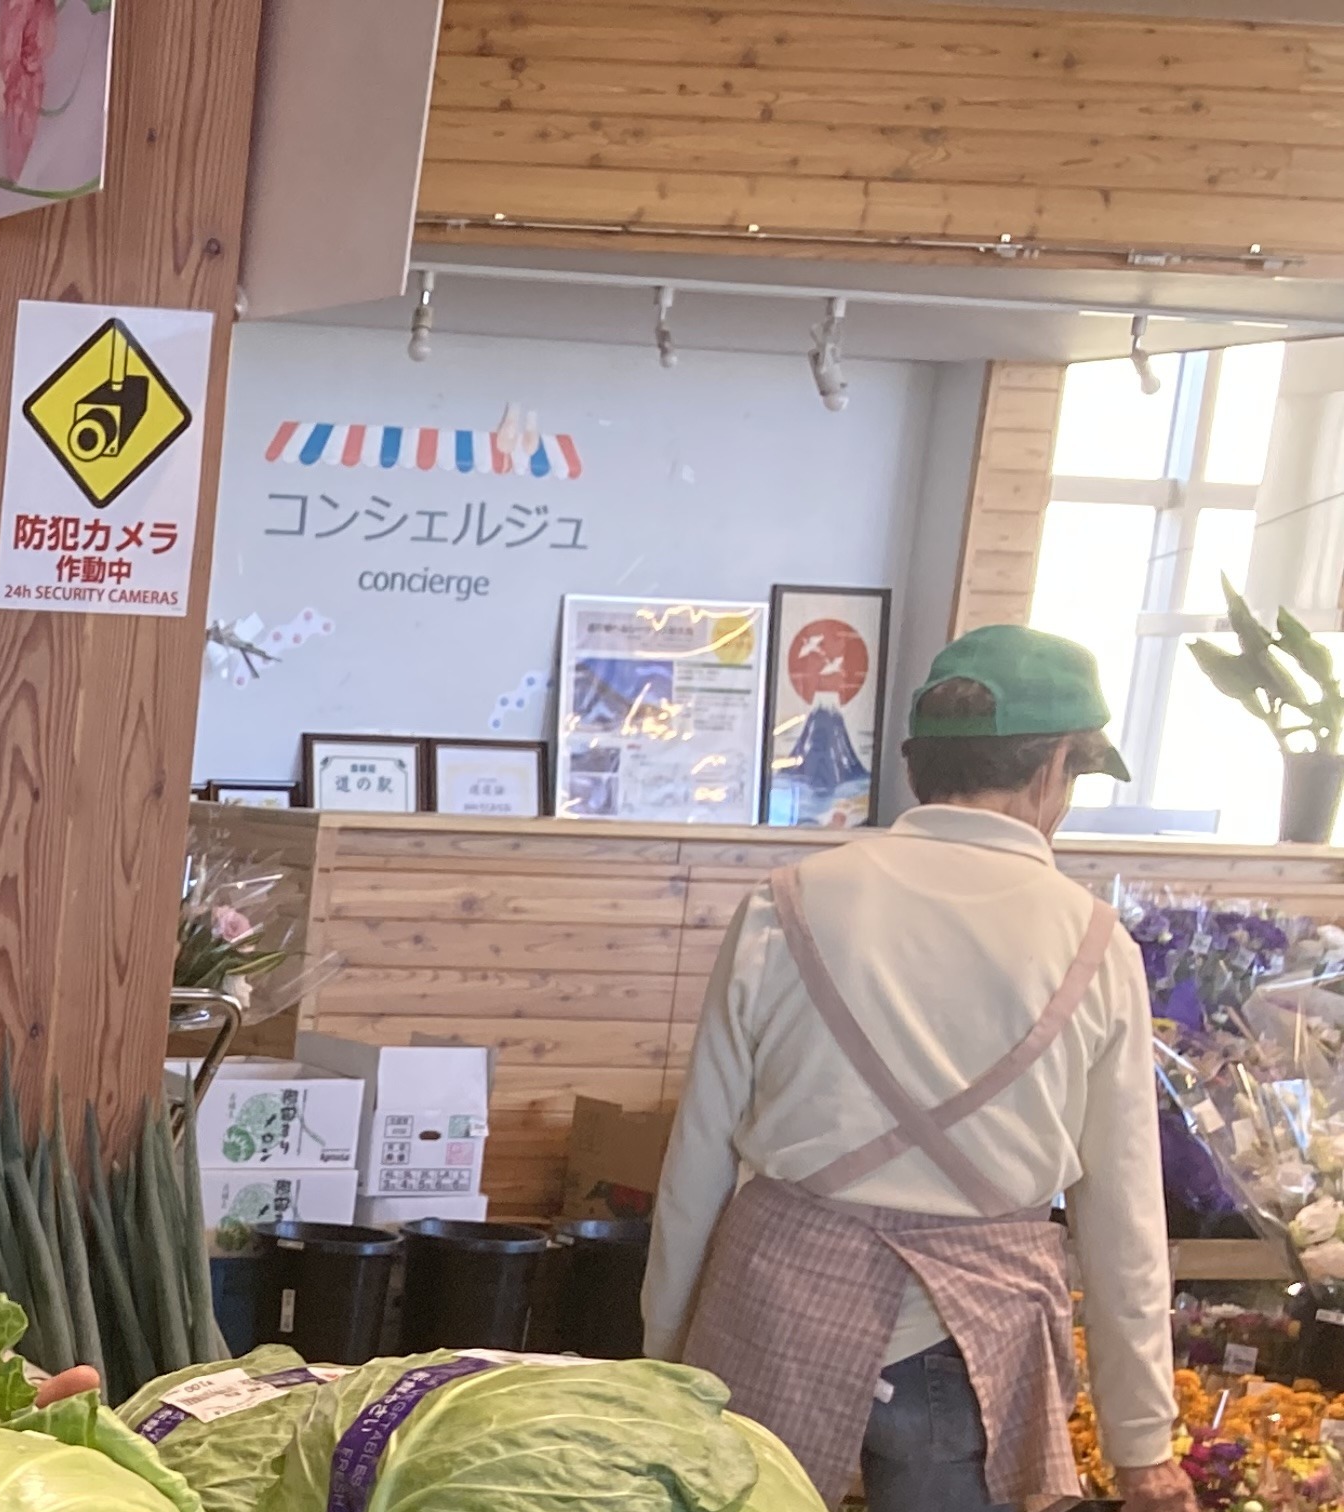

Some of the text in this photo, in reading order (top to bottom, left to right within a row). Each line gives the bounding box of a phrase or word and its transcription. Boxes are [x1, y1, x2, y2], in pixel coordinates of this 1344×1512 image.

[13, 513, 179, 555] 防犯カメラ
[264, 492, 588, 551] コンシェルジュ
[55, 554, 133, 585] 作動中
[358, 567, 491, 602] concierge
[4, 584, 179, 605] 24h SECURITY CAMERAS
[334, 774, 395, 794] 道の駅
